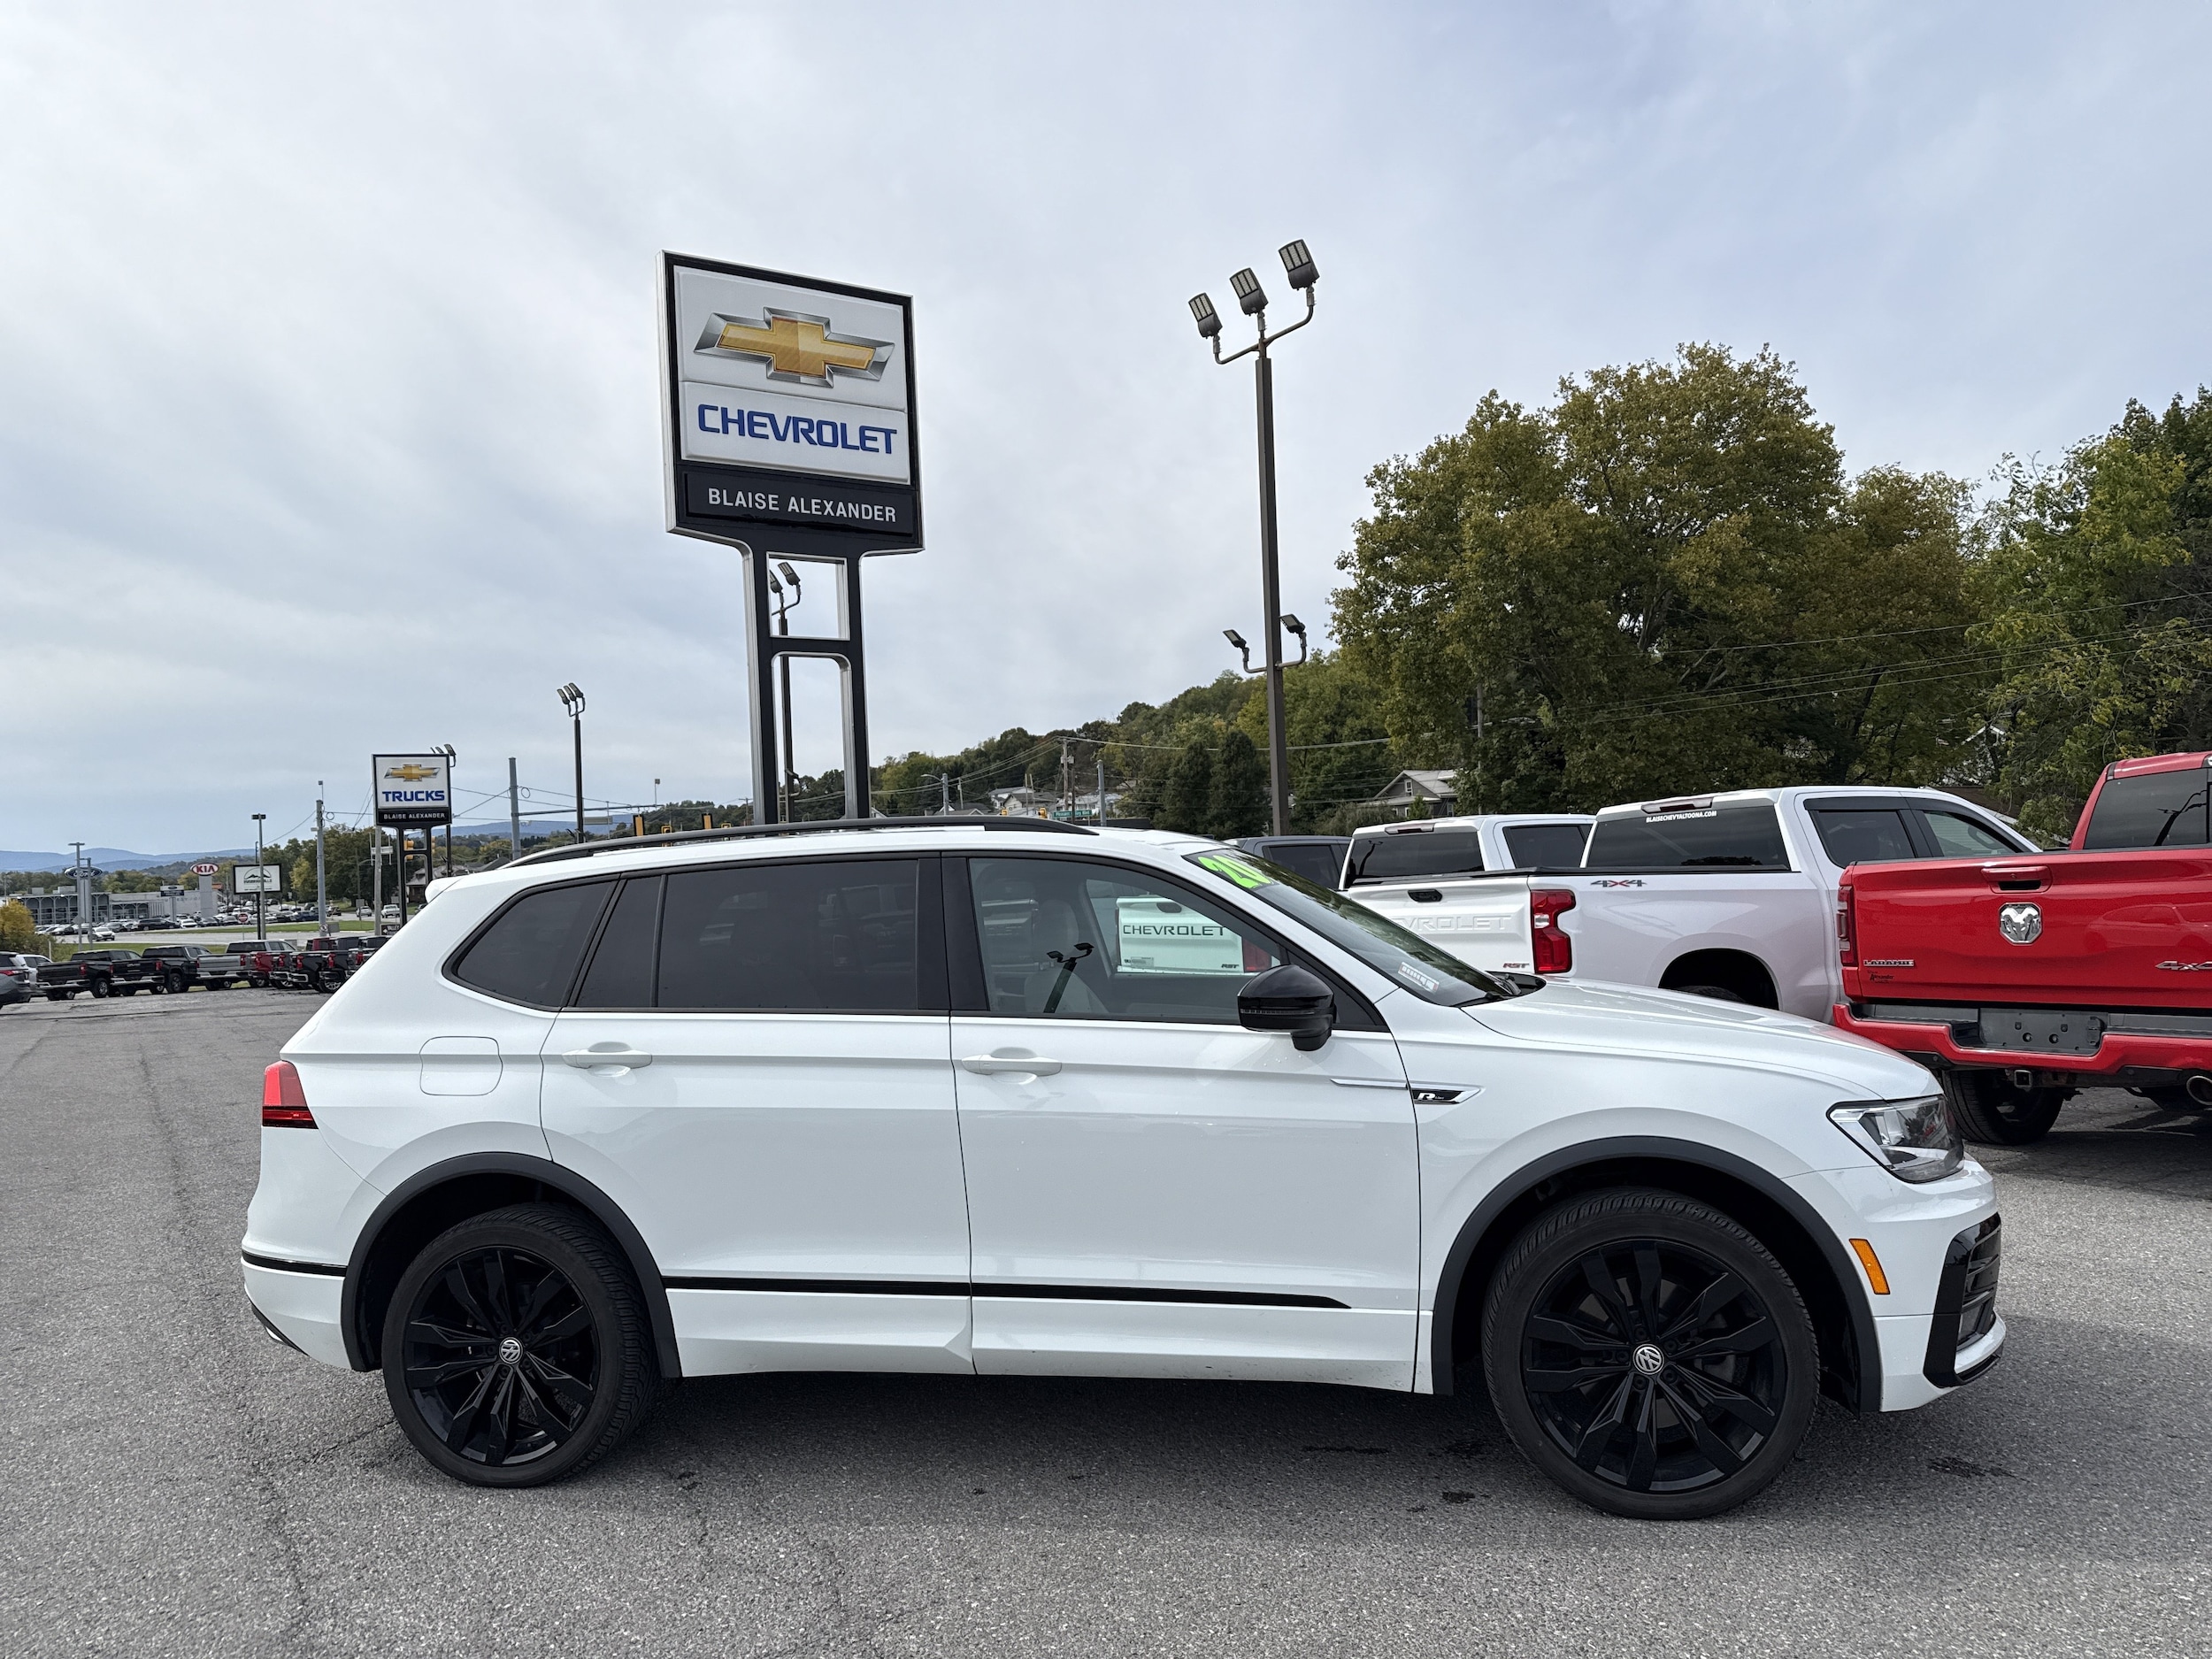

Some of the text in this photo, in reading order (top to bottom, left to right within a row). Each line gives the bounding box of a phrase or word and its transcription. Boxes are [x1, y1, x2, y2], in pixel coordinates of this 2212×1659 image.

[698, 403, 897, 454] CHEVROLET
[708, 488, 896, 523] BLAISE ALEXANDER
[382, 790, 445, 803] TRUCKS
[196, 864, 215, 873] KIA
[1123, 925, 1225, 936] CHEVROLET
